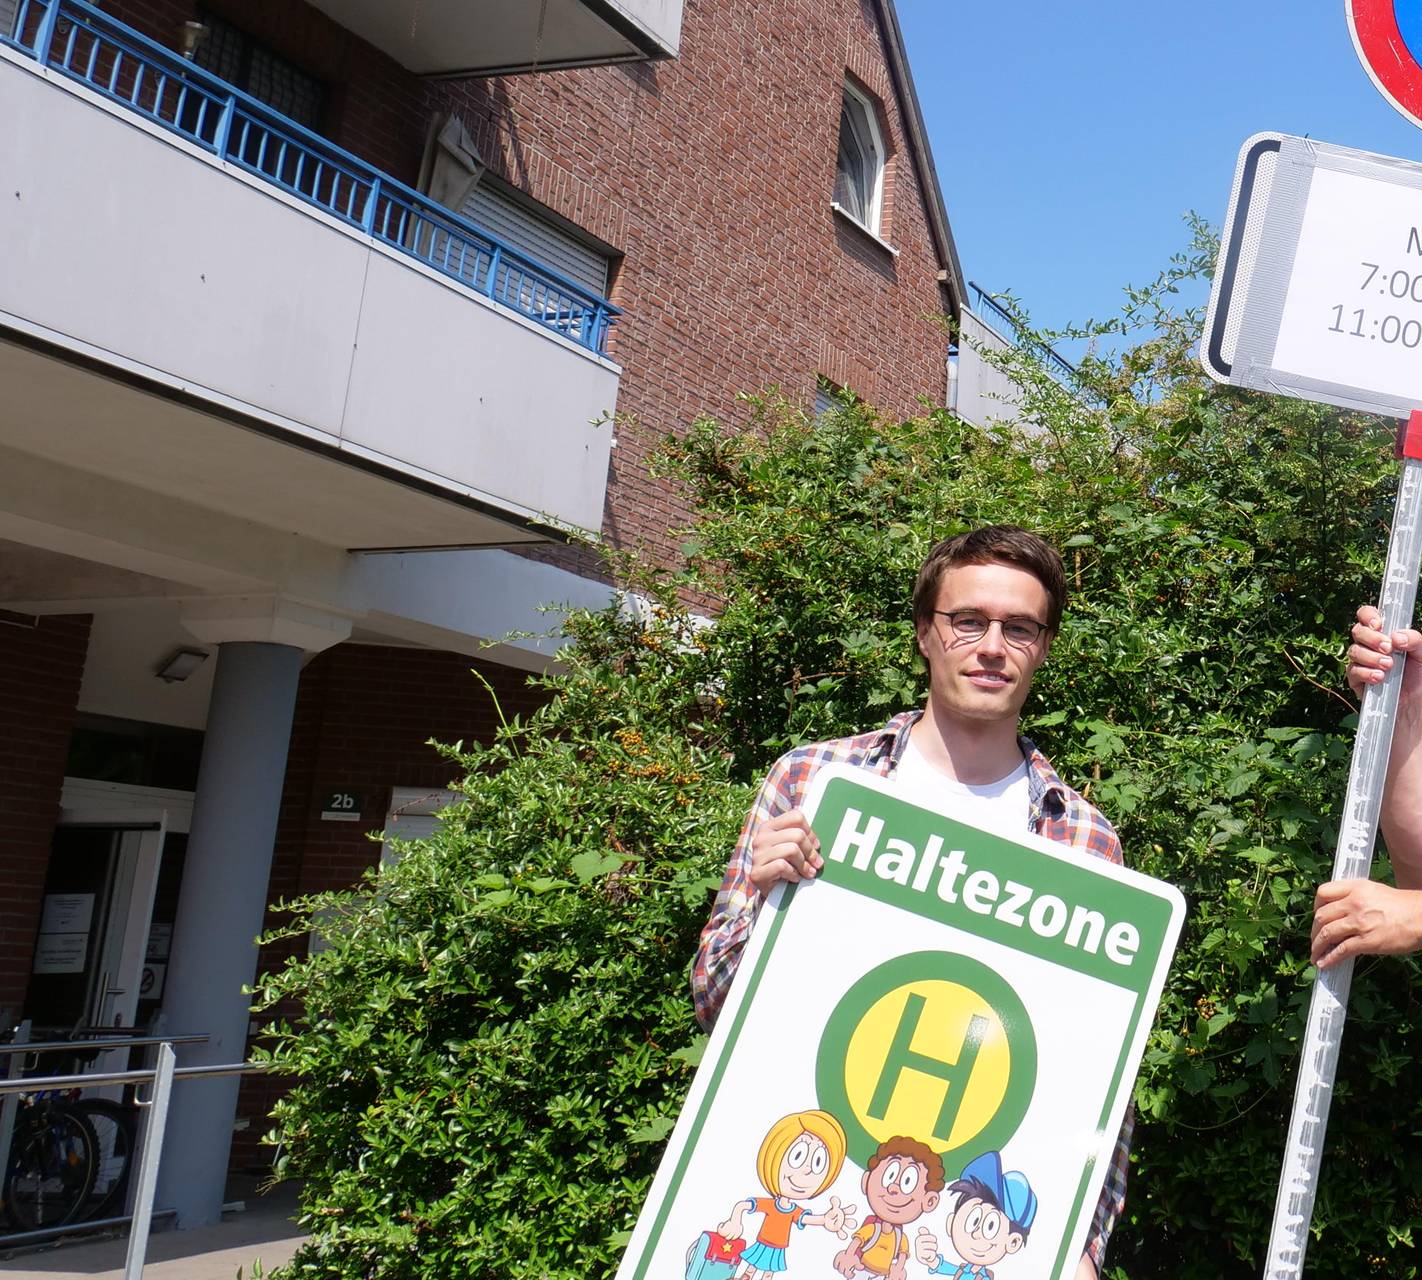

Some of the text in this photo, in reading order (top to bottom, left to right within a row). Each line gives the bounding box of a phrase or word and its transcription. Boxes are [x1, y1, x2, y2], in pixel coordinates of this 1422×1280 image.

[331, 793, 355, 809] 2b
[828, 808, 1140, 966] Haltezone
[866, 992, 990, 1142] H
